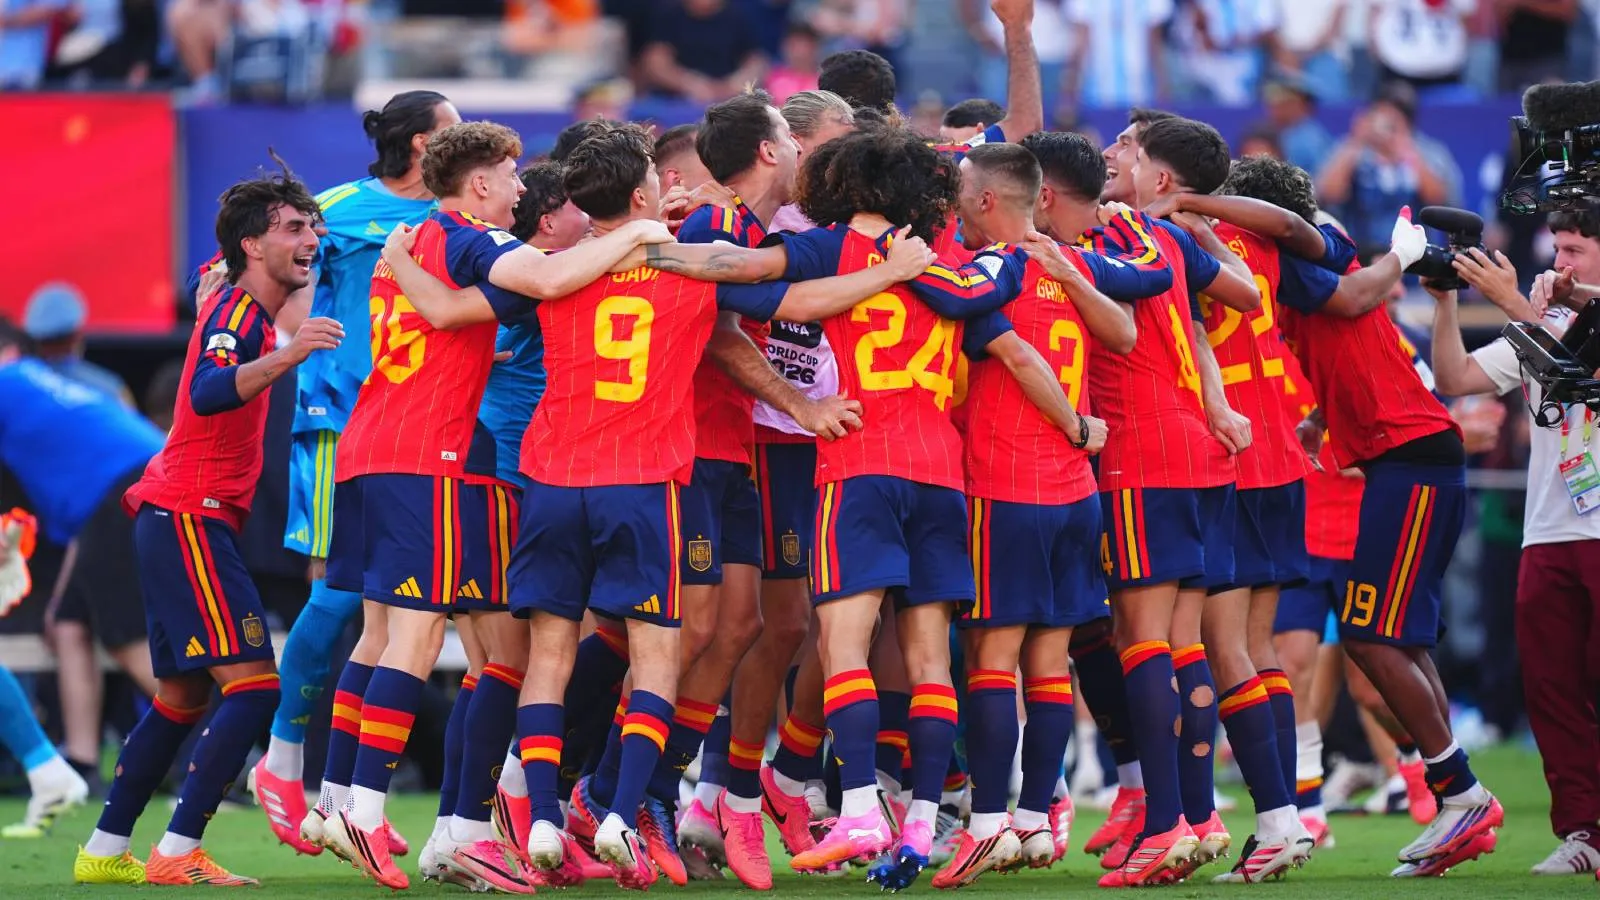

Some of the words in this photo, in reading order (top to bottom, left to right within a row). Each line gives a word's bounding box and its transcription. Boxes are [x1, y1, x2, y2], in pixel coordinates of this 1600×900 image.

[594, 295, 655, 403] 9
[767, 344, 798, 361] ORLD
[798, 353, 818, 367] CUP
[780, 320, 810, 337] FIFA
[851, 292, 954, 412] 24
[1048, 319, 1084, 413] 3
[1341, 580, 1377, 627] 19
